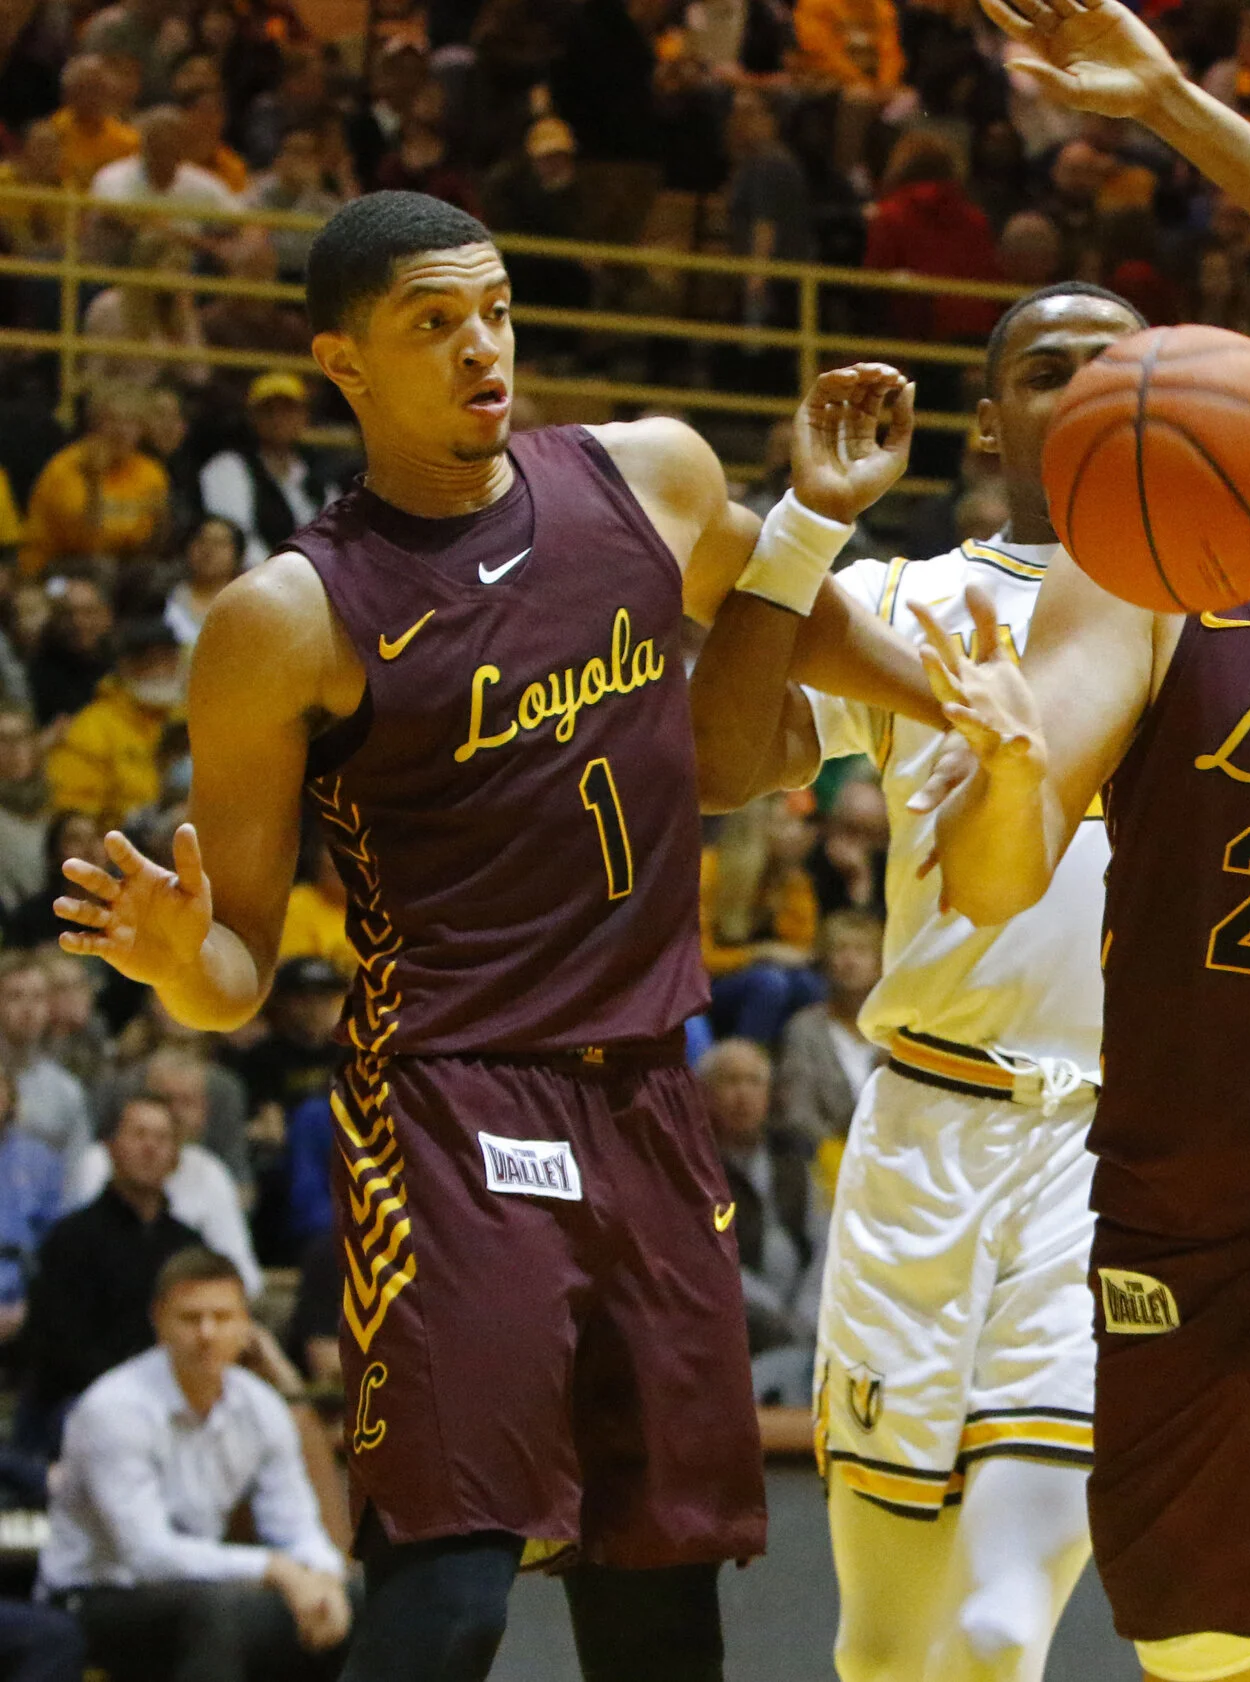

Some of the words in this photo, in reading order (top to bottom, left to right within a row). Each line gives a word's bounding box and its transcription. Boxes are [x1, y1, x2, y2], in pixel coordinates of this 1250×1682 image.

[453, 607, 665, 763] Loyola
[579, 757, 633, 901] 1
[483, 1141, 572, 1192] VALLEY
[1104, 1277, 1176, 1327] VALLEY
